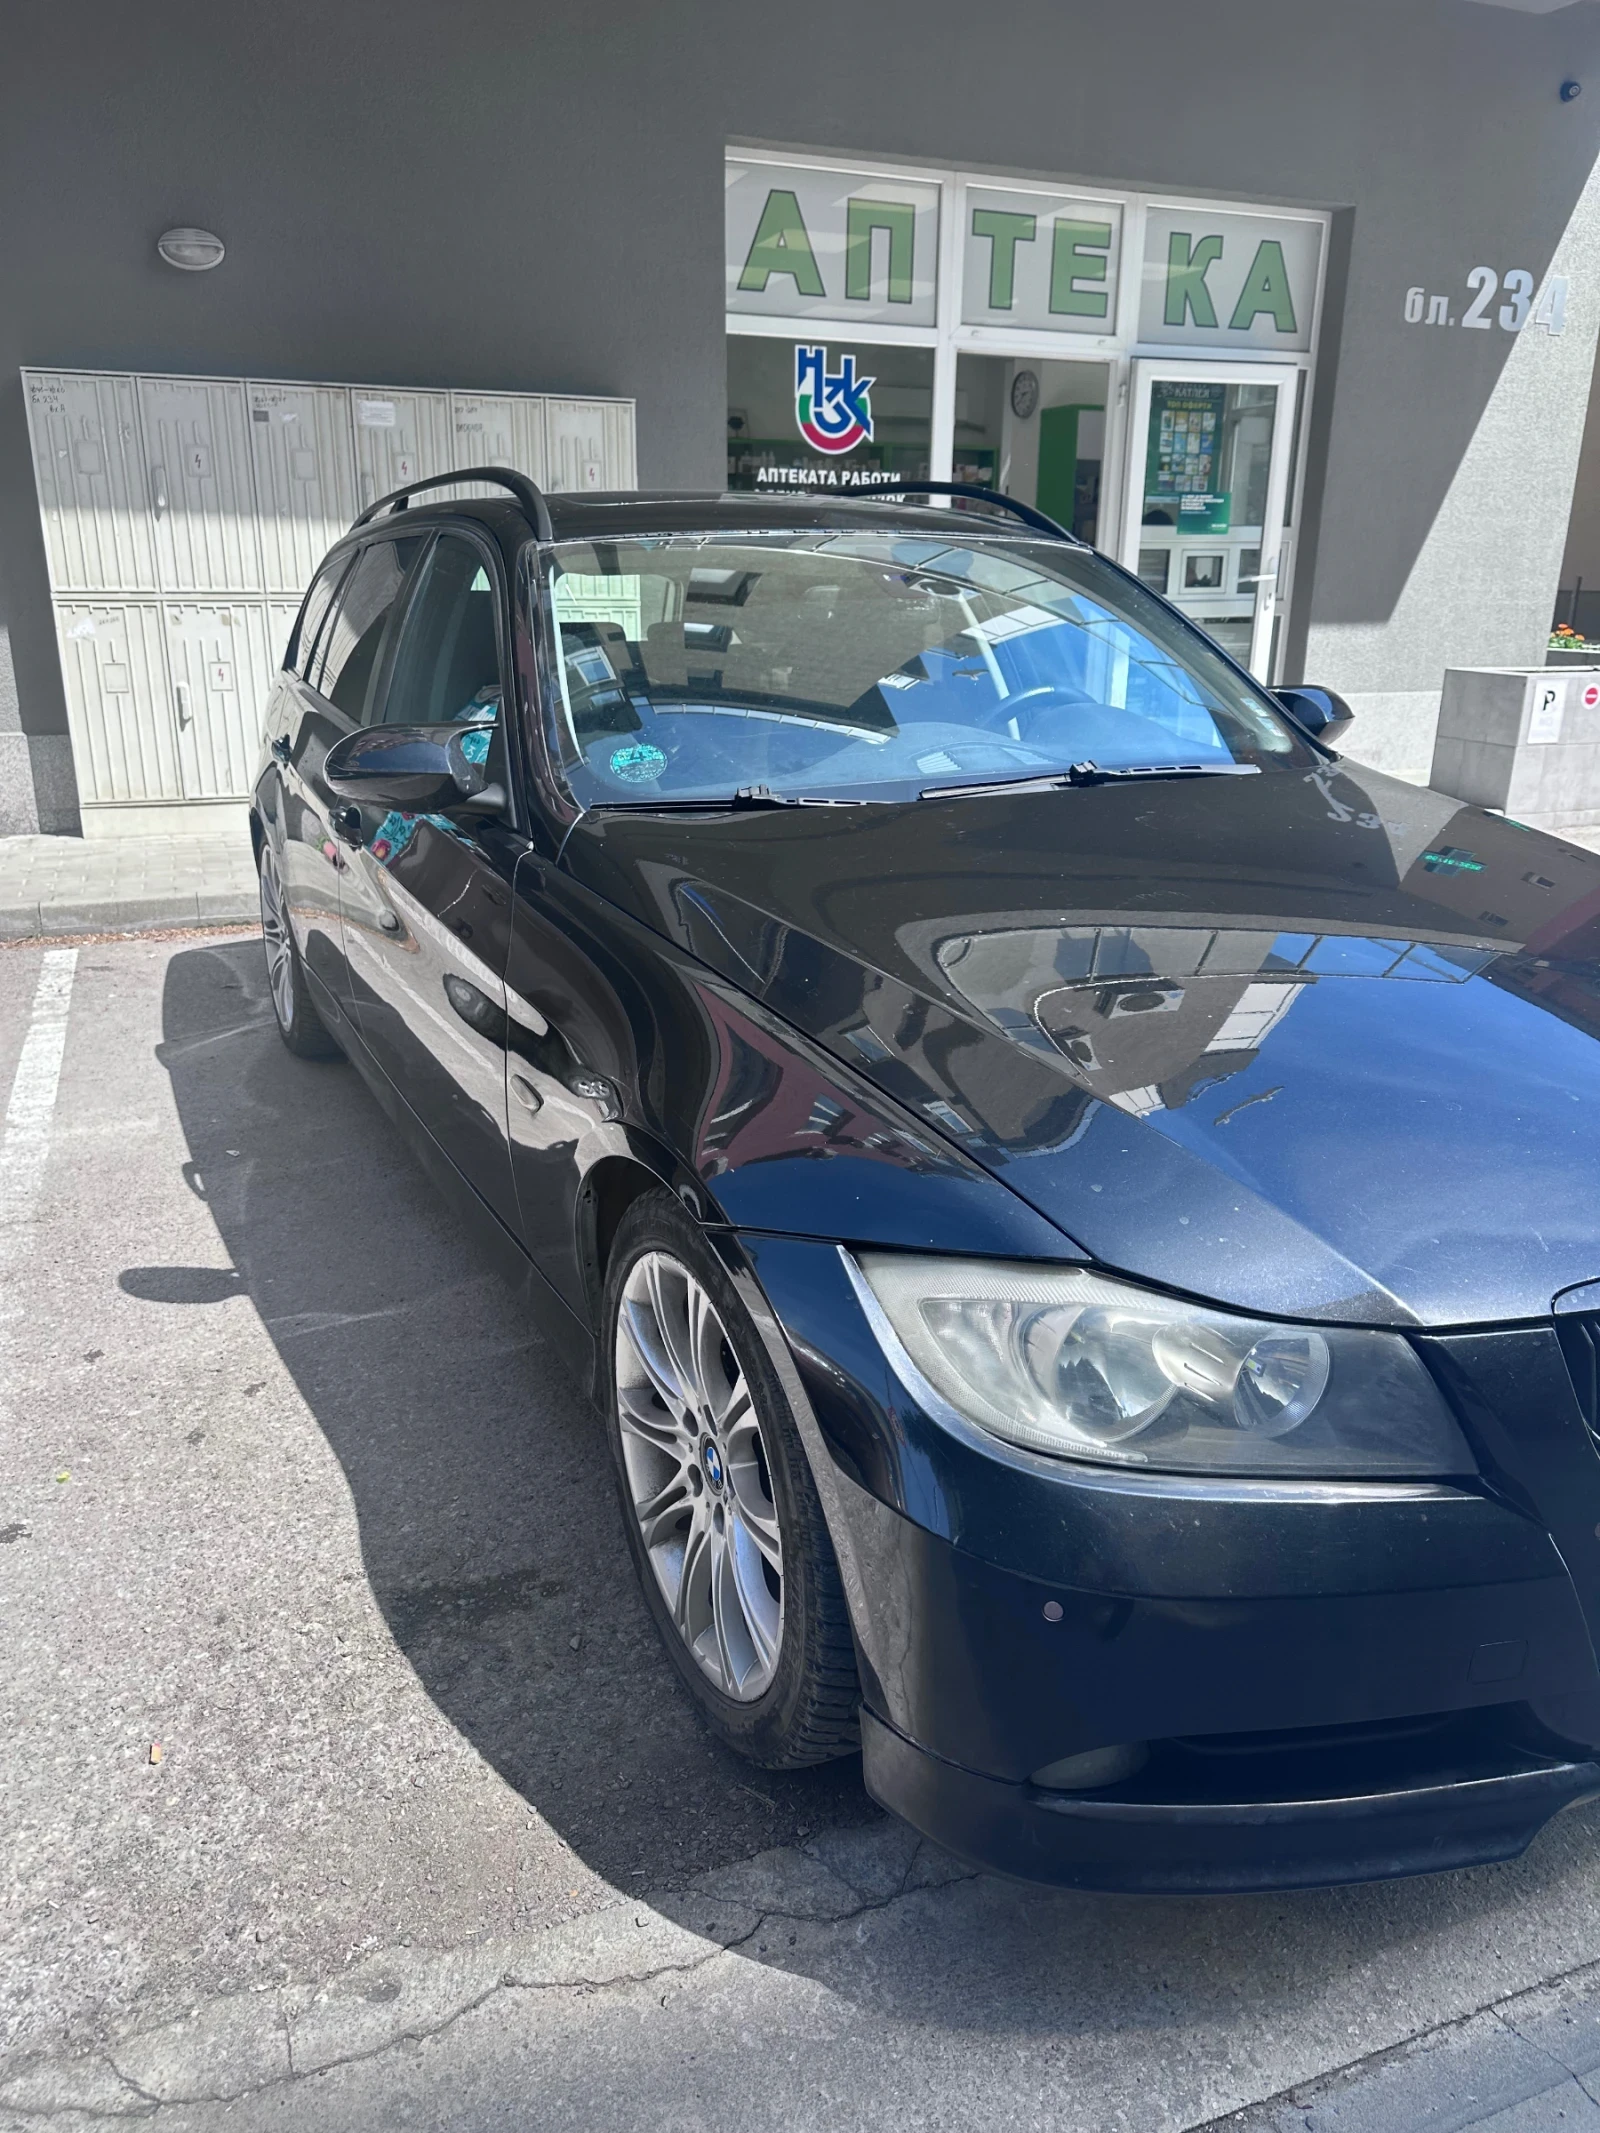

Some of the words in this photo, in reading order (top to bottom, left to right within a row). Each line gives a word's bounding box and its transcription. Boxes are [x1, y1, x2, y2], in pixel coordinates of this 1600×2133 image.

[737, 188, 1298, 334] АПТЕКА
[757, 467, 838, 485] АПТЕКАТА
[841, 470, 901, 486] РАБОТИ
